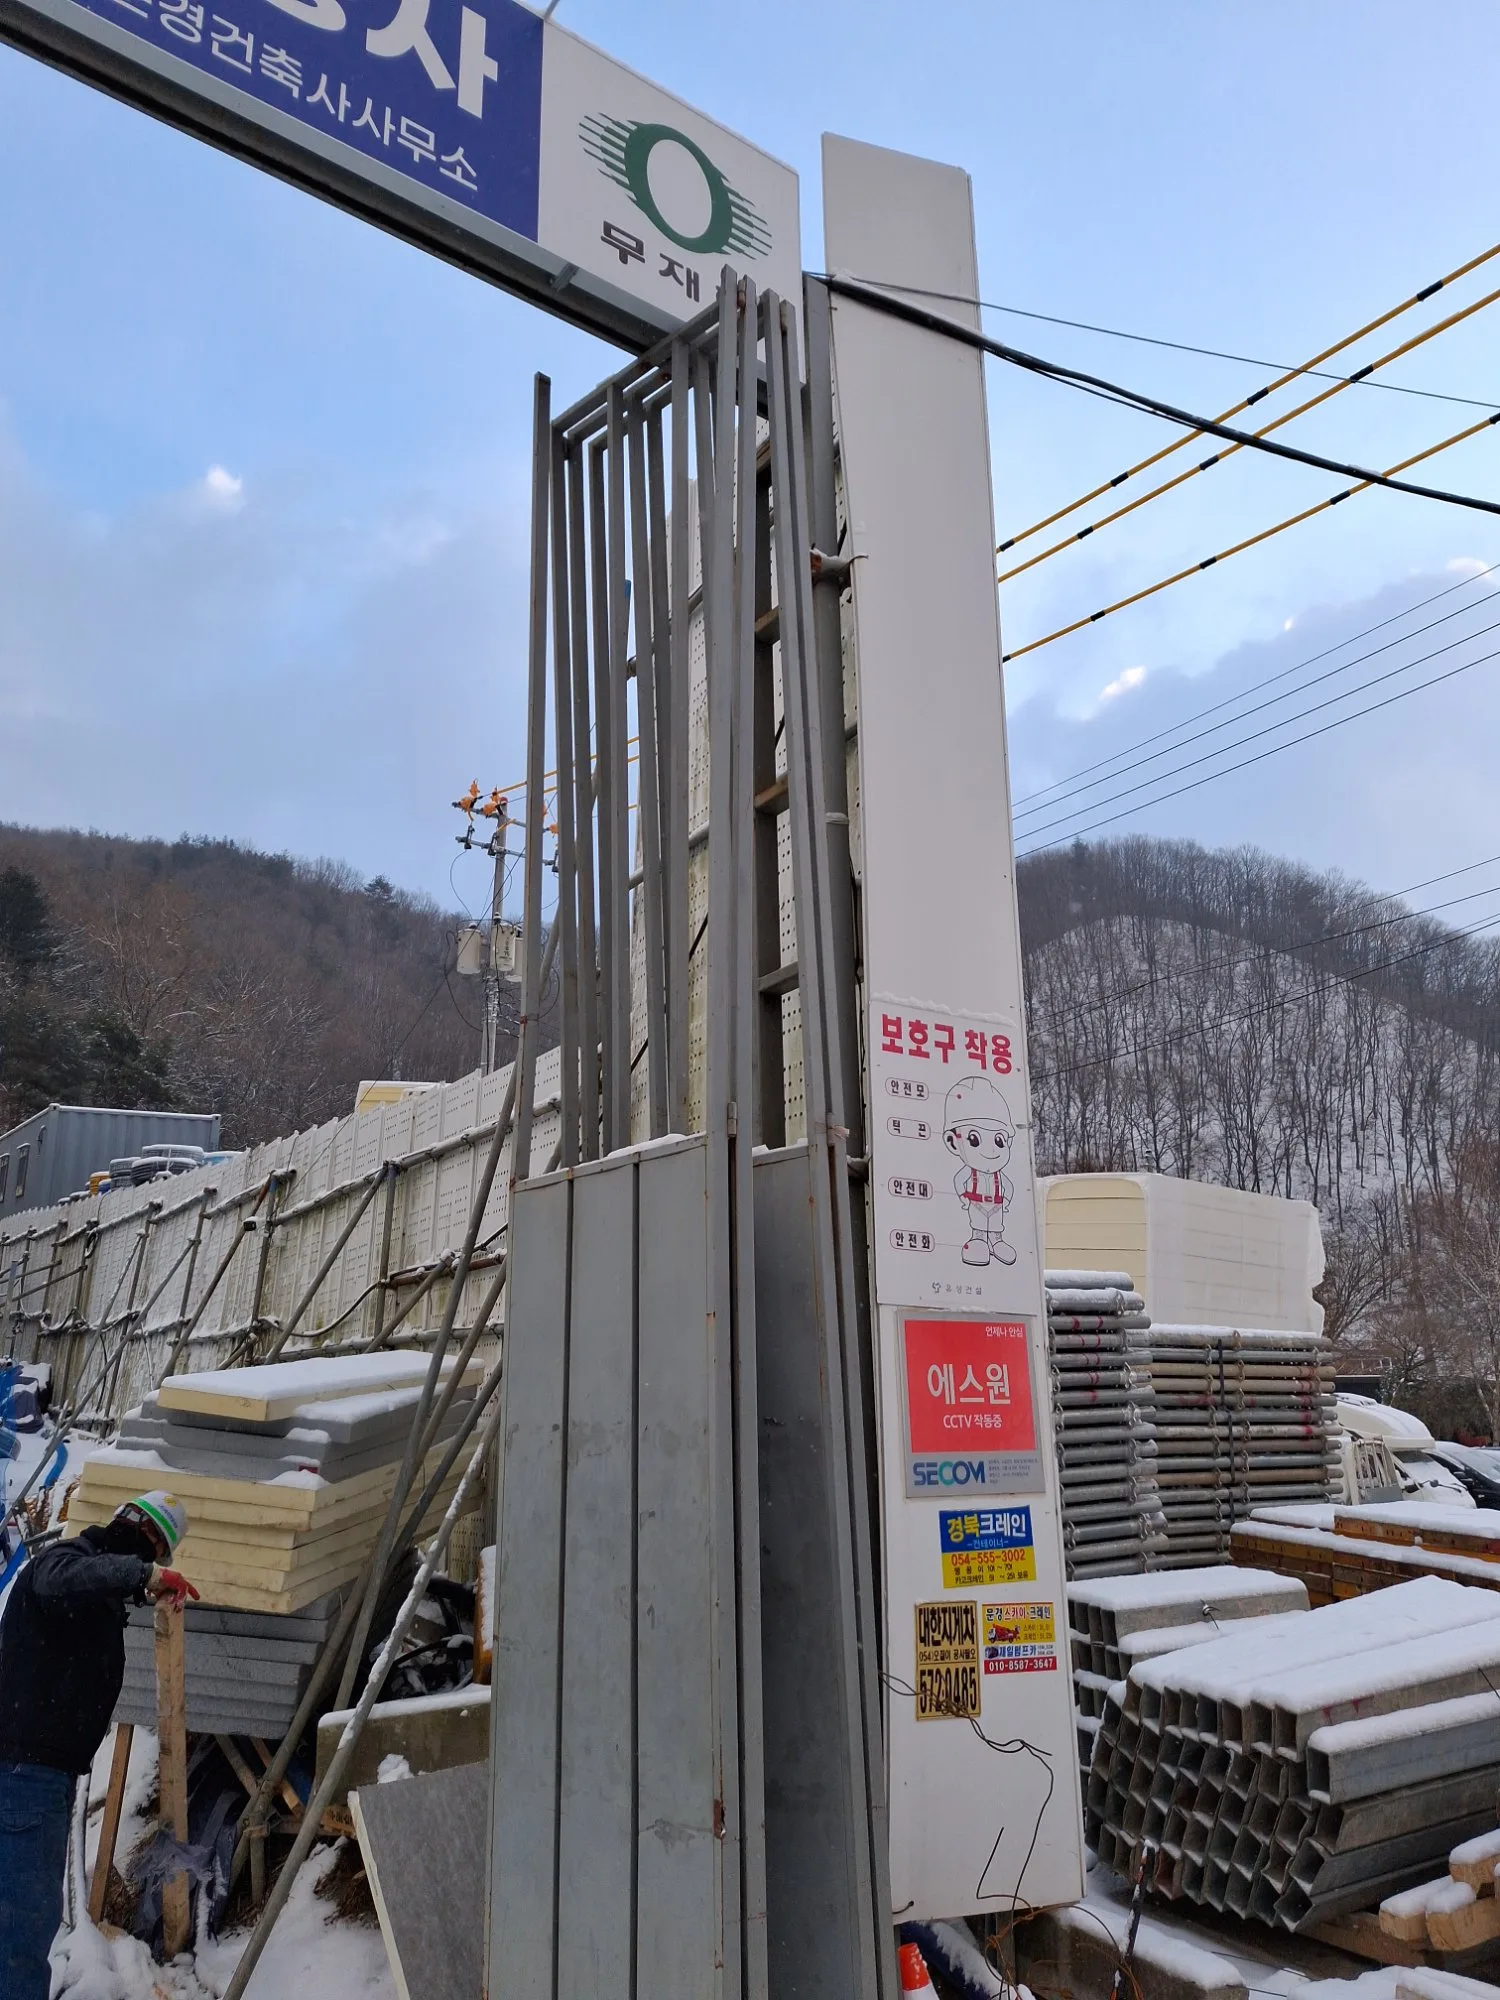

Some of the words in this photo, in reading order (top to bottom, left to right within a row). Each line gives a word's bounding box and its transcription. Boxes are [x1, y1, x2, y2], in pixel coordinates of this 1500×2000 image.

[882, 1013, 955, 1064] 보호구
[964, 1028, 1013, 1075] 착용
[890, 1079, 925, 1098] 안전모
[893, 1179, 928, 1198] 안전대
[895, 1231, 930, 1250] 안전화
[985, 1325, 1007, 1337] 언제나
[1008, 1326, 1024, 1338] 안심
[927, 1363, 1011, 1405] 에스원
[943, 1414, 972, 1429] CCTV
[973, 1413, 1003, 1429] 작동중
[912, 1460, 986, 1486] SECOM
[951, 1548, 1026, 1567] 054-555-3002
[918, 1605, 976, 1648] 대한지게차
[988, 1658, 1054, 1672] 010-8587-3647
